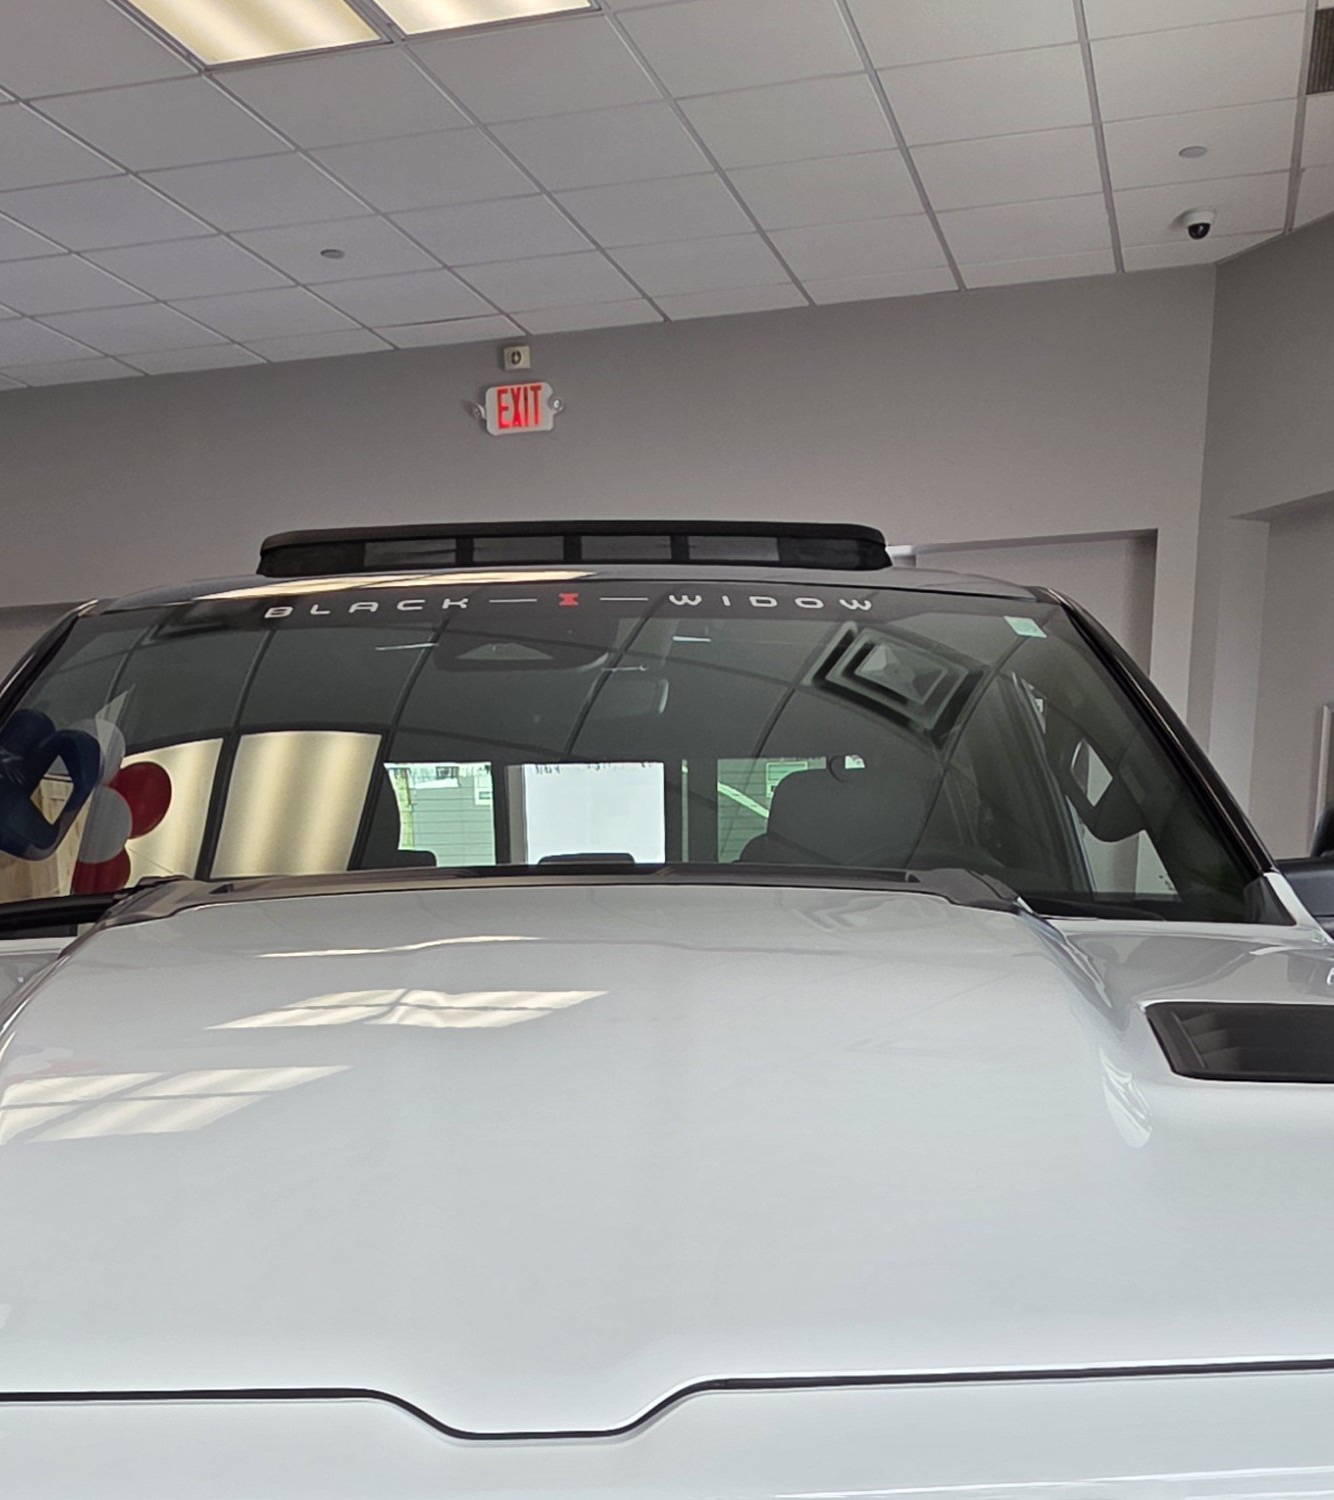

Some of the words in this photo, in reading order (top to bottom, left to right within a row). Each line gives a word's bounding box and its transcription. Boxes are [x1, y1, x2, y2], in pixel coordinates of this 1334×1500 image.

[496, 385, 542, 429] EXIT
[264, 598, 469, 619] BLACK
[668, 595, 872, 611] WIDOW
